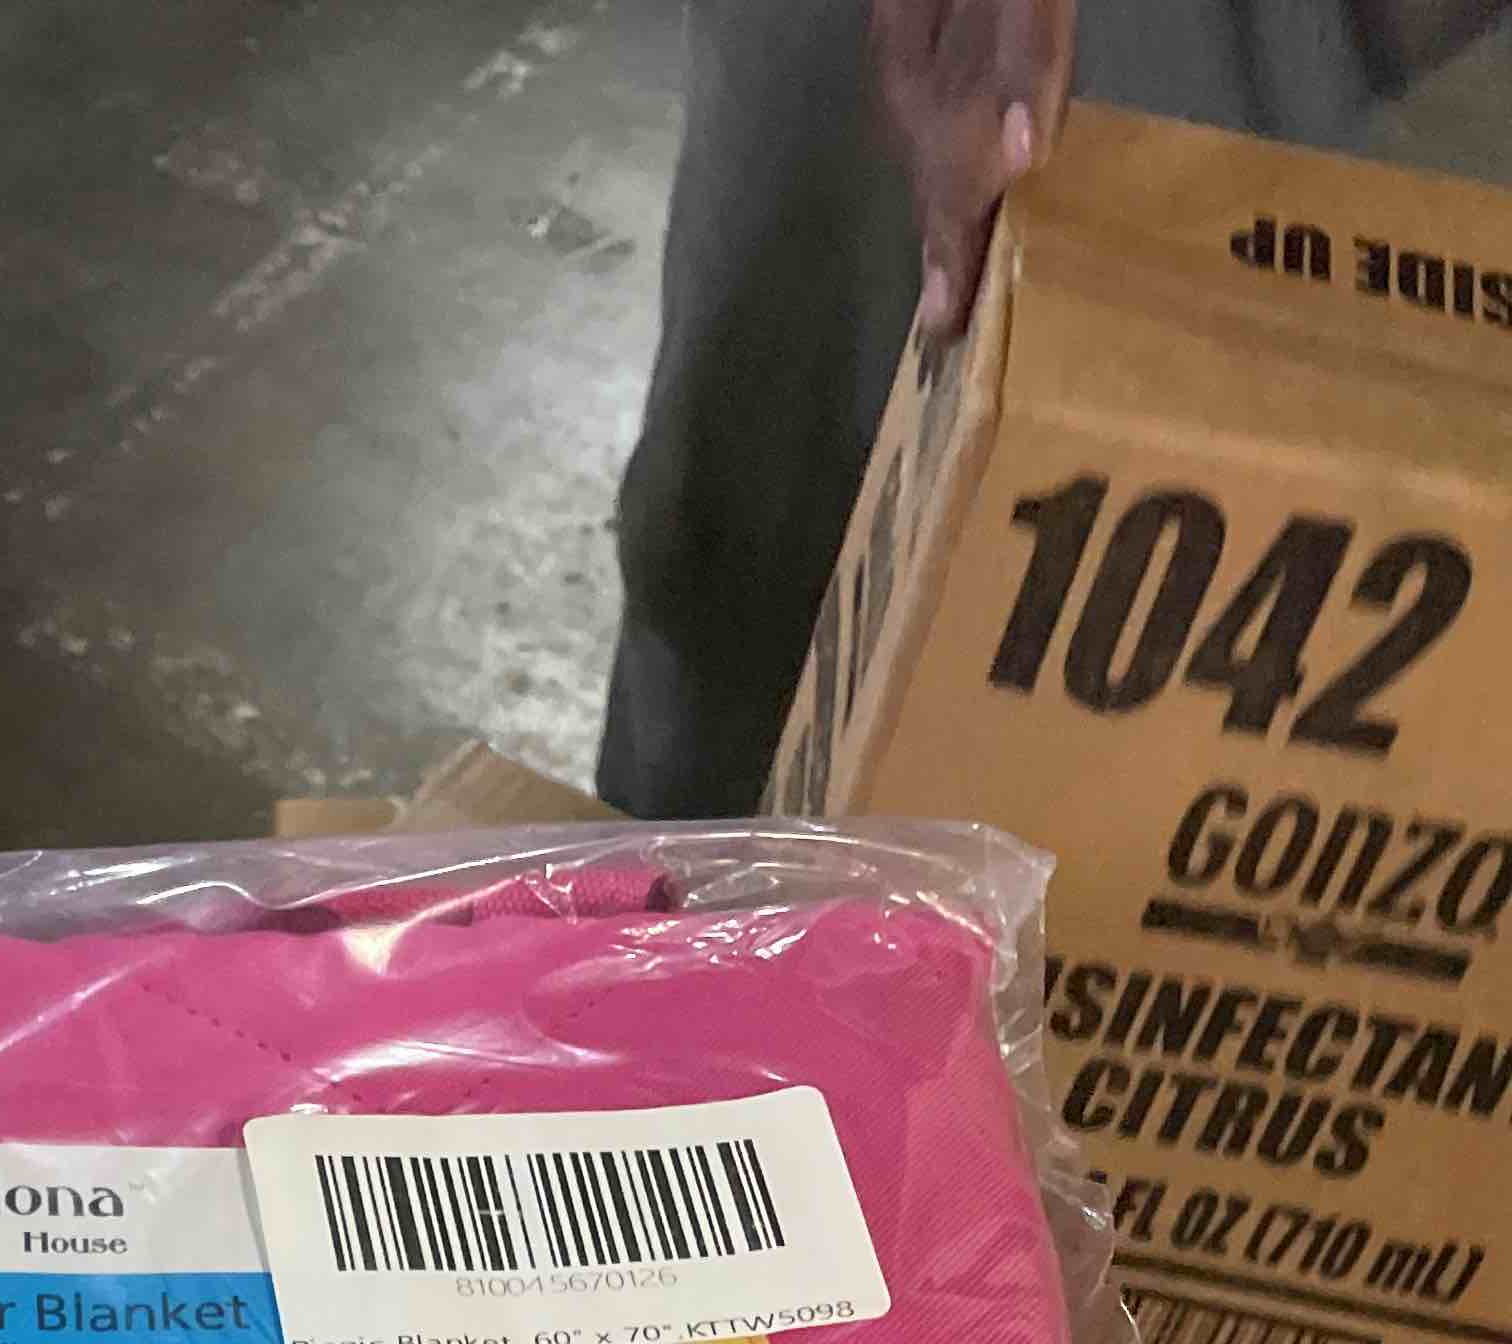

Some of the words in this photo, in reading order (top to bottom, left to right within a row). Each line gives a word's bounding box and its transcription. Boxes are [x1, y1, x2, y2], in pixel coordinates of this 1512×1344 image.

[1230, 216, 1331, 281] UP
[988, 471, 1473, 756] 1042
[1167, 784, 1512, 936] GONZO
[1045, 954, 1512, 1118] SINFECTAN
[1061, 1057, 1385, 1180] CITRUS
[23, 1231, 128, 1255] House
[455, 1267, 678, 1297] 810045670126
[1112, 1176, 1169, 1242] FL
[1171, 1186, 1252, 1255] OZ
[1243, 1202, 1372, 1280] (710
[1364, 1237, 1485, 1306] mL)
[37, 1291, 251, 1332] Blanket
[595, 1331, 613, 1344] x
